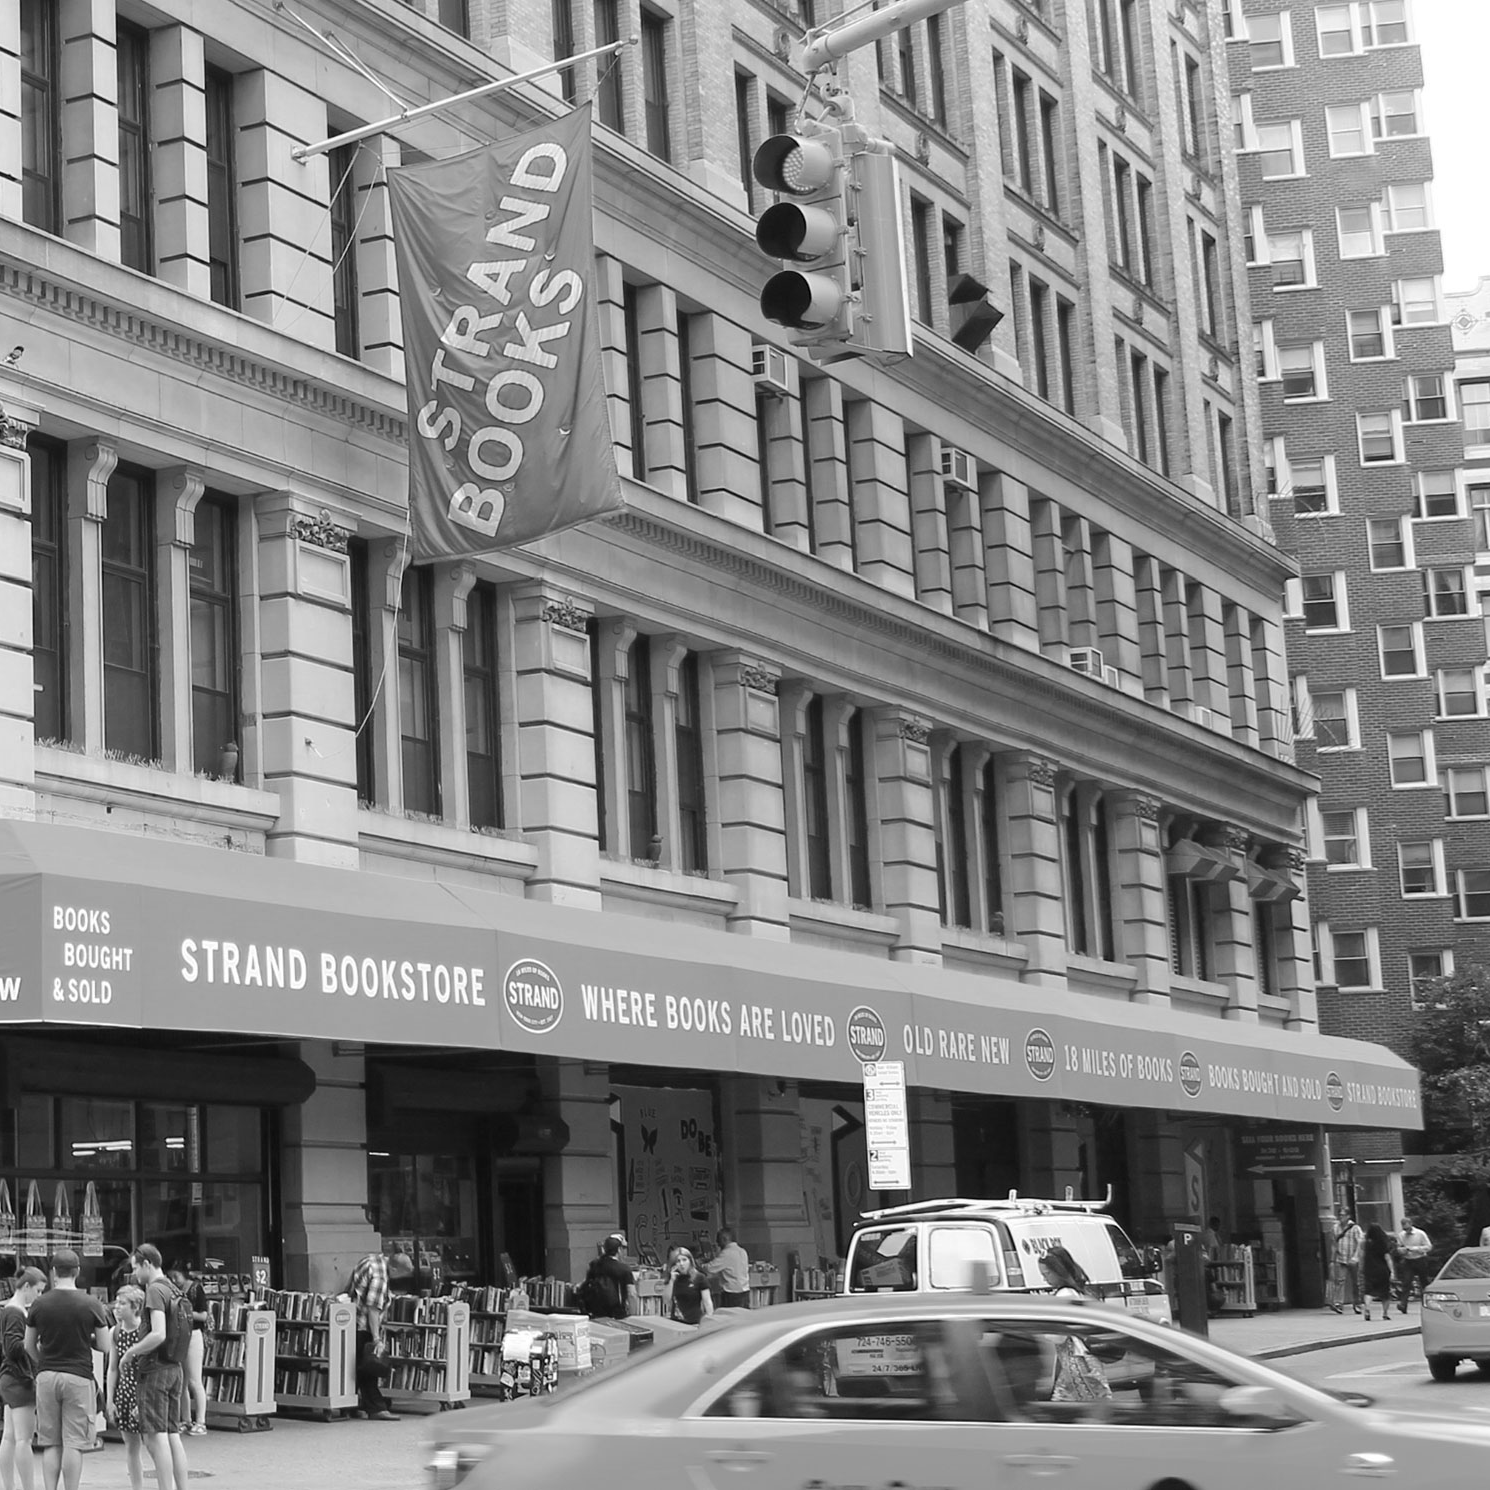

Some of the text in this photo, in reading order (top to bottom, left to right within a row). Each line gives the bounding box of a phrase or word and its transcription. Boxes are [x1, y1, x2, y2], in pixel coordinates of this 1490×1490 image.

[416, 142, 568, 452] STRAND
[447, 267, 583, 537] BOOKS
[53, 905, 110, 934] BOOKS
[64, 942, 133, 971] BOUGHT
[181, 938, 486, 1006] STRAND BOOKSTORE
[53, 977, 112, 1004] & SOLD
[509, 981, 560, 1010] STRAND
[581, 984, 835, 1047] WHERE BOOKS ARE LOVED
[850, 1025, 884, 1047] STRAND
[903, 1024, 1010, 1064] OLD RARE NEW
[1026, 1045, 1054, 1063] STRAND
[1064, 1044, 1173, 1082] 18 MILES OF BOOKS
[1208, 1064, 1322, 1100] BOOKS BOUGHT AND SOLD
[1347, 1082, 1417, 1108] STRAND BOOKSTORE
[1183, 1233, 1193, 1246] P
[255, 1269, 267, 1284] $2
